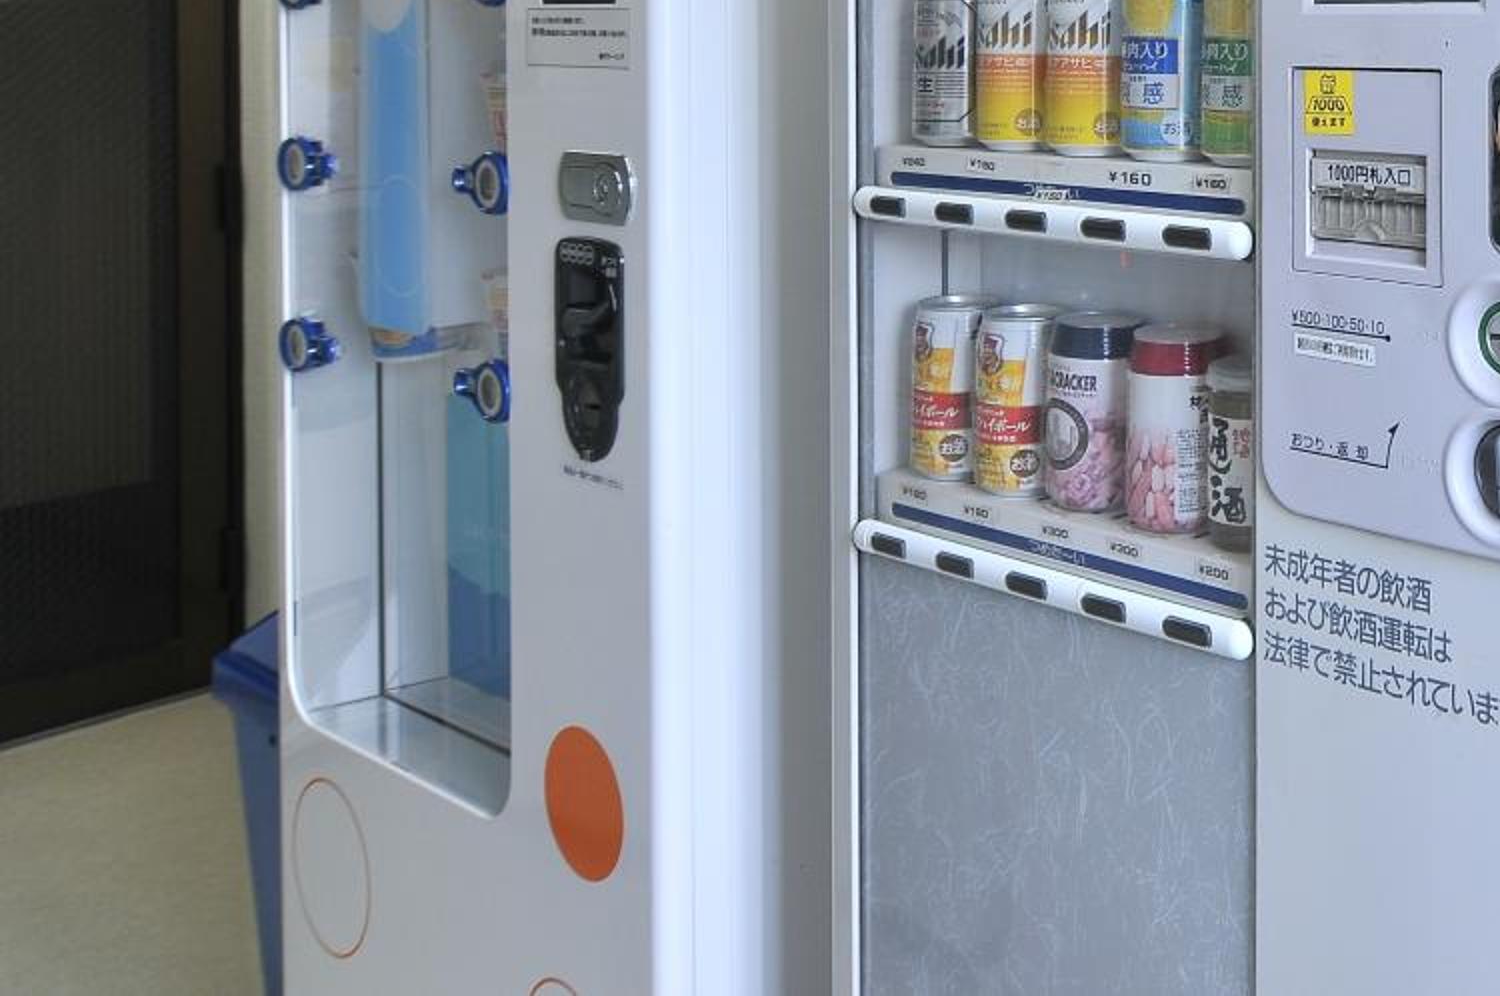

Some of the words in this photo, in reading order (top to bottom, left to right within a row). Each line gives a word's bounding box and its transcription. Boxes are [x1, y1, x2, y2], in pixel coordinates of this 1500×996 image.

[1122, 41, 1168, 59] 肉入り
[1202, 42, 1249, 61] 肉入り
[1109, 171, 1152, 187] ¥160
[1327, 163, 1412, 187] 1000円札入口
[1265, 543, 1431, 614] 未成年者の飲酒
[1265, 588, 1451, 663] および飲酒運転は
